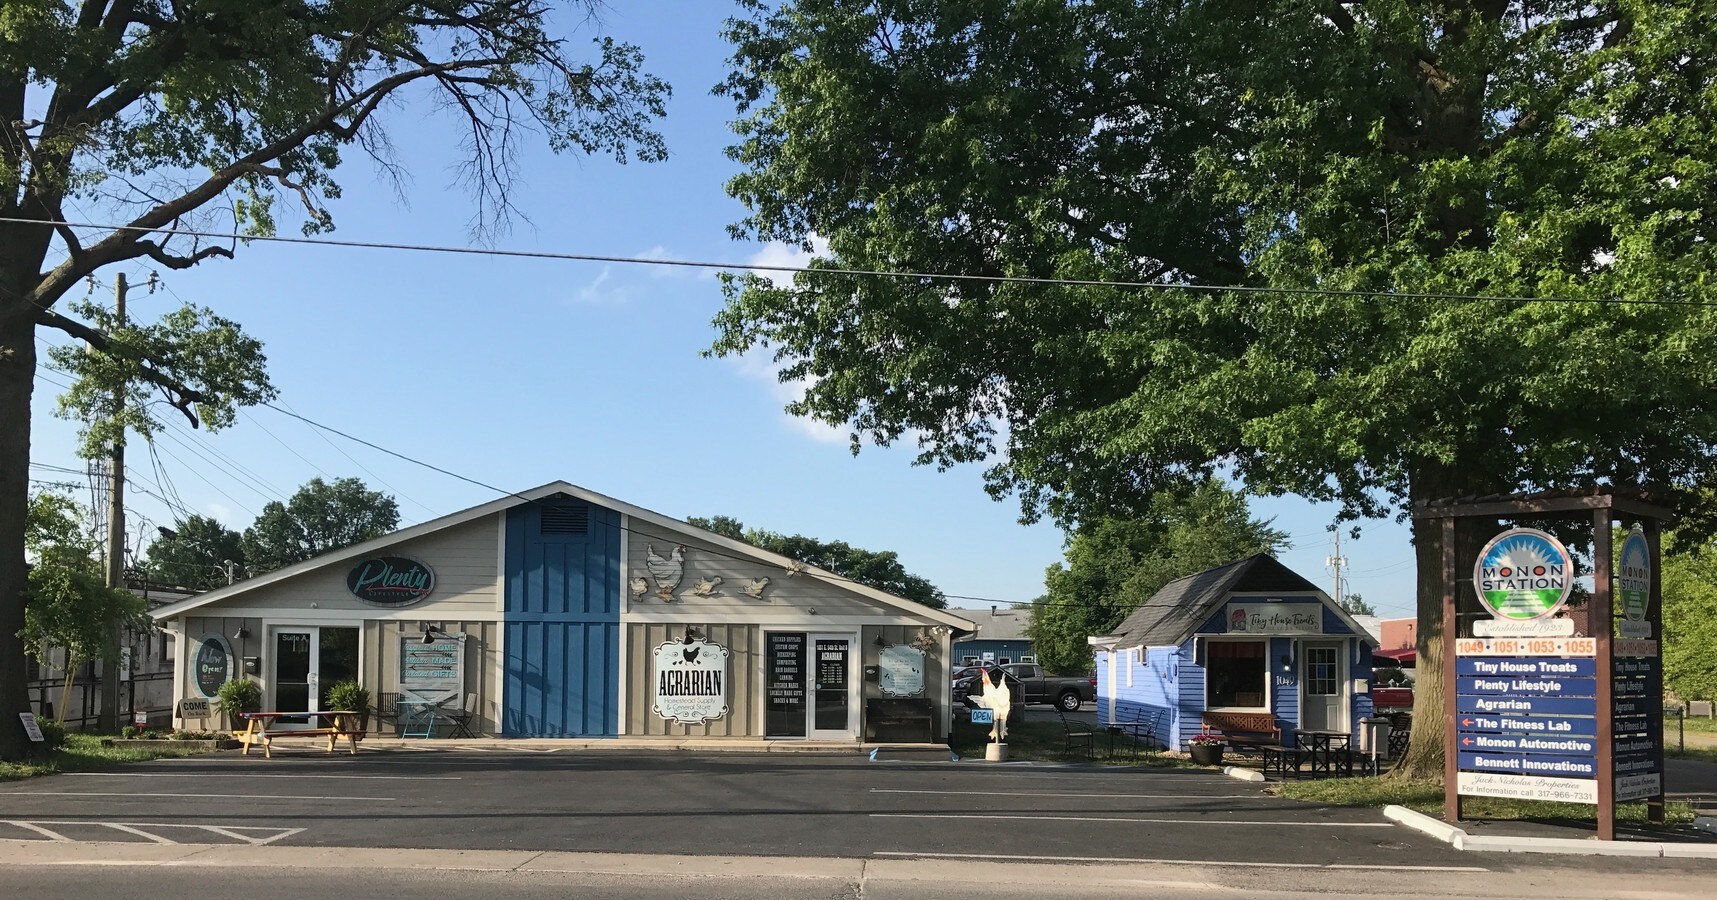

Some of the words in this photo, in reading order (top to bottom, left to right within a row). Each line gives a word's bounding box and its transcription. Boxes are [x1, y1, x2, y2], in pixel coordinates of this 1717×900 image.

[353, 559, 428, 596] Plenty
[1483, 565, 1563, 579] MONON
[1622, 566, 1648, 579] MONON
[1483, 578, 1563, 591] STATION
[1622, 579, 1648, 592] STATION
[1250, 613, 1267, 629] Tiny
[1268, 613, 1292, 626] House
[1292, 613, 1319, 629] Treats
[1484, 623, 1538, 632] Established
[1458, 641, 1484, 653] 1049
[1493, 641, 1518, 653] 1051
[1527, 641, 1555, 653] 1053
[1564, 641, 1593, 653] 1055
[1474, 662, 1498, 673] Tiny
[1500, 662, 1536, 672] House
[1539, 662, 1577, 672] Treats
[659, 670, 721, 696] AGRARIAN
[1276, 676, 1294, 685] 1049
[1475, 680, 1509, 692] Plenty
[1512, 680, 1561, 692] Lifestyle
[183, 702, 207, 710] COME
[1476, 699, 1531, 710] Agrarian
[1615, 702, 1635, 713] Agrarian
[973, 712, 991, 721] OPEN
[1475, 718, 1498, 728] The
[1501, 719, 1545, 730] Fitness
[1548, 721, 1571, 731] Lab
[1615, 722, 1624, 731] The
[1477, 737, 1516, 747] Monon
[1519, 739, 1591, 751] Automotive
[1475, 757, 1519, 768] Bennett
[1523, 759, 1592, 772] Innovations
[1472, 776, 1493, 785] Jack
[1494, 777, 1531, 786] Nicholas
[1534, 780, 1580, 790] Properties
[1477, 786, 1517, 795] Information
[1538, 790, 1593, 800] 317-966-7331
